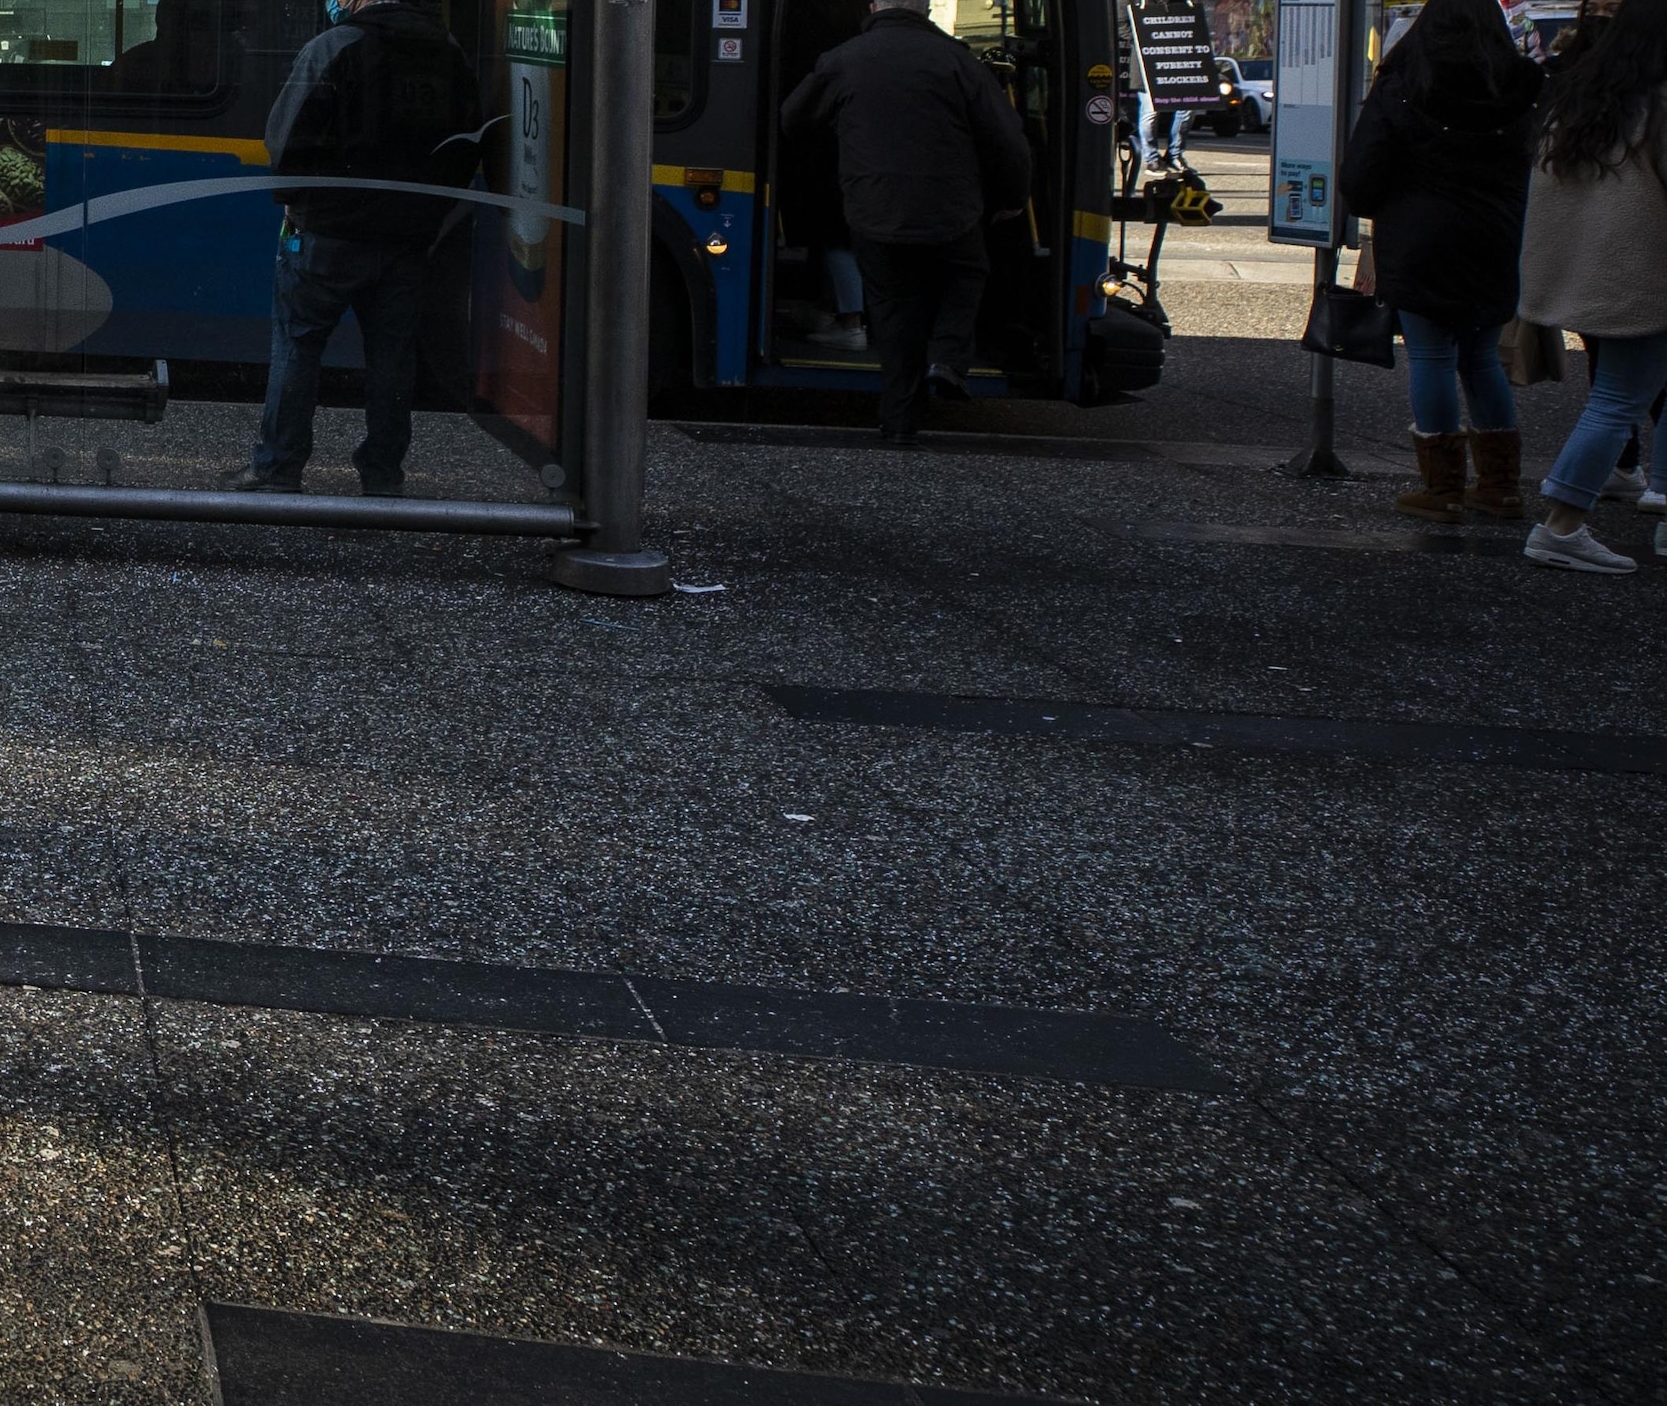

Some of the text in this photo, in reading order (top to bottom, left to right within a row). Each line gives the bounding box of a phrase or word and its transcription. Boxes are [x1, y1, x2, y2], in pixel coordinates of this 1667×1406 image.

[1143, 15, 1195, 25] CHILDREN
[1151, 30, 1194, 40] CANNOT
[1142, 45, 1211, 55] CONSENT TO
[1155, 60, 1203, 70] PUBERTY
[1156, 75, 1210, 85] BLOCKERS
[1280, 161, 1312, 171] More ways
